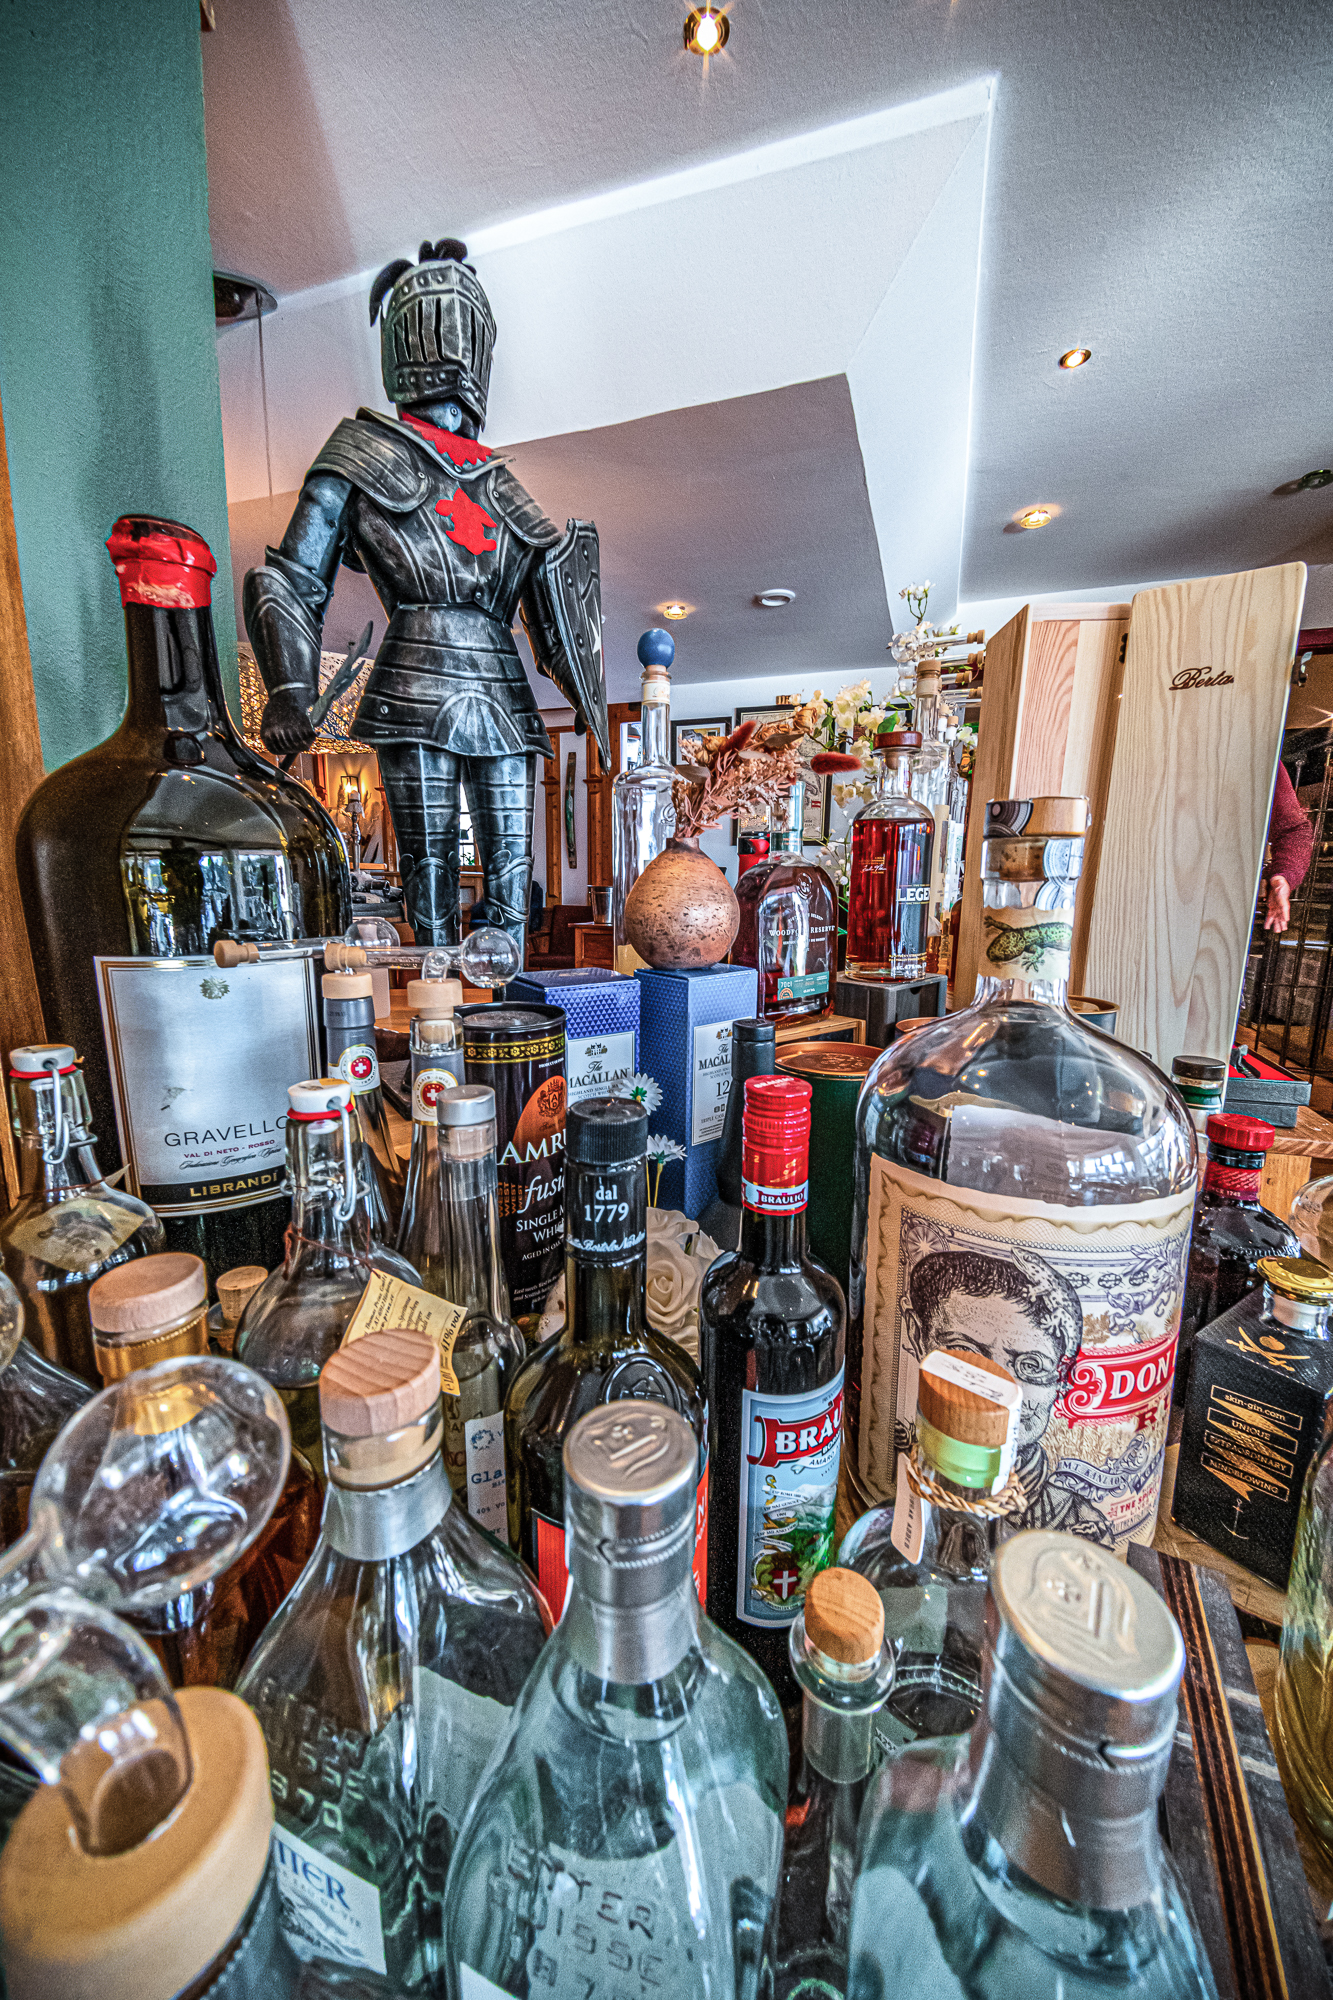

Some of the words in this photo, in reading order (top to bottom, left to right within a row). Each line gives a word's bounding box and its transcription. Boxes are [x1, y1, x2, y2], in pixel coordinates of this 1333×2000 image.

[1168, 666, 1234, 691] Berta
[896, 887, 930, 902] LEGE
[769, 928, 806, 937] WOODF
[810, 925, 836, 934] RESERVE
[717, 1043, 729, 1055] The
[586, 1060, 603, 1074] The
[698, 1054, 731, 1070] MACAL
[716, 1080, 730, 1098] 12
[164, 1115, 287, 1147] GRAVELLO
[184, 1150, 201, 1158] VAL
[216, 1147, 239, 1155] NETO
[248, 1139, 275, 1149] ROSSO
[496, 1128, 566, 1166] AMR
[190, 1172, 278, 1197] LIBRANDI
[517, 1167, 566, 1214] fusi
[595, 1184, 618, 1200] dal
[761, 1191, 804, 1205] BRAULIO
[516, 1210, 558, 1232] SINGLE
[584, 1202, 630, 1223] 1779
[533, 1219, 564, 1243] WHI
[522, 1250, 541, 1261] AGED
[449, 1309, 462, 1328] vol
[1109, 1350, 1171, 1400] DON
[1224, 1394, 1286, 1422] skin-gin.com
[774, 1408, 840, 1454] BRAU
[1231, 1419, 1271, 1441] UNIQUE
[1210, 1434, 1287, 1472] EXTRAORDINARY
[471, 1469, 504, 1485] Gla
[1209, 1458, 1279, 1494] MINDBLOWING
